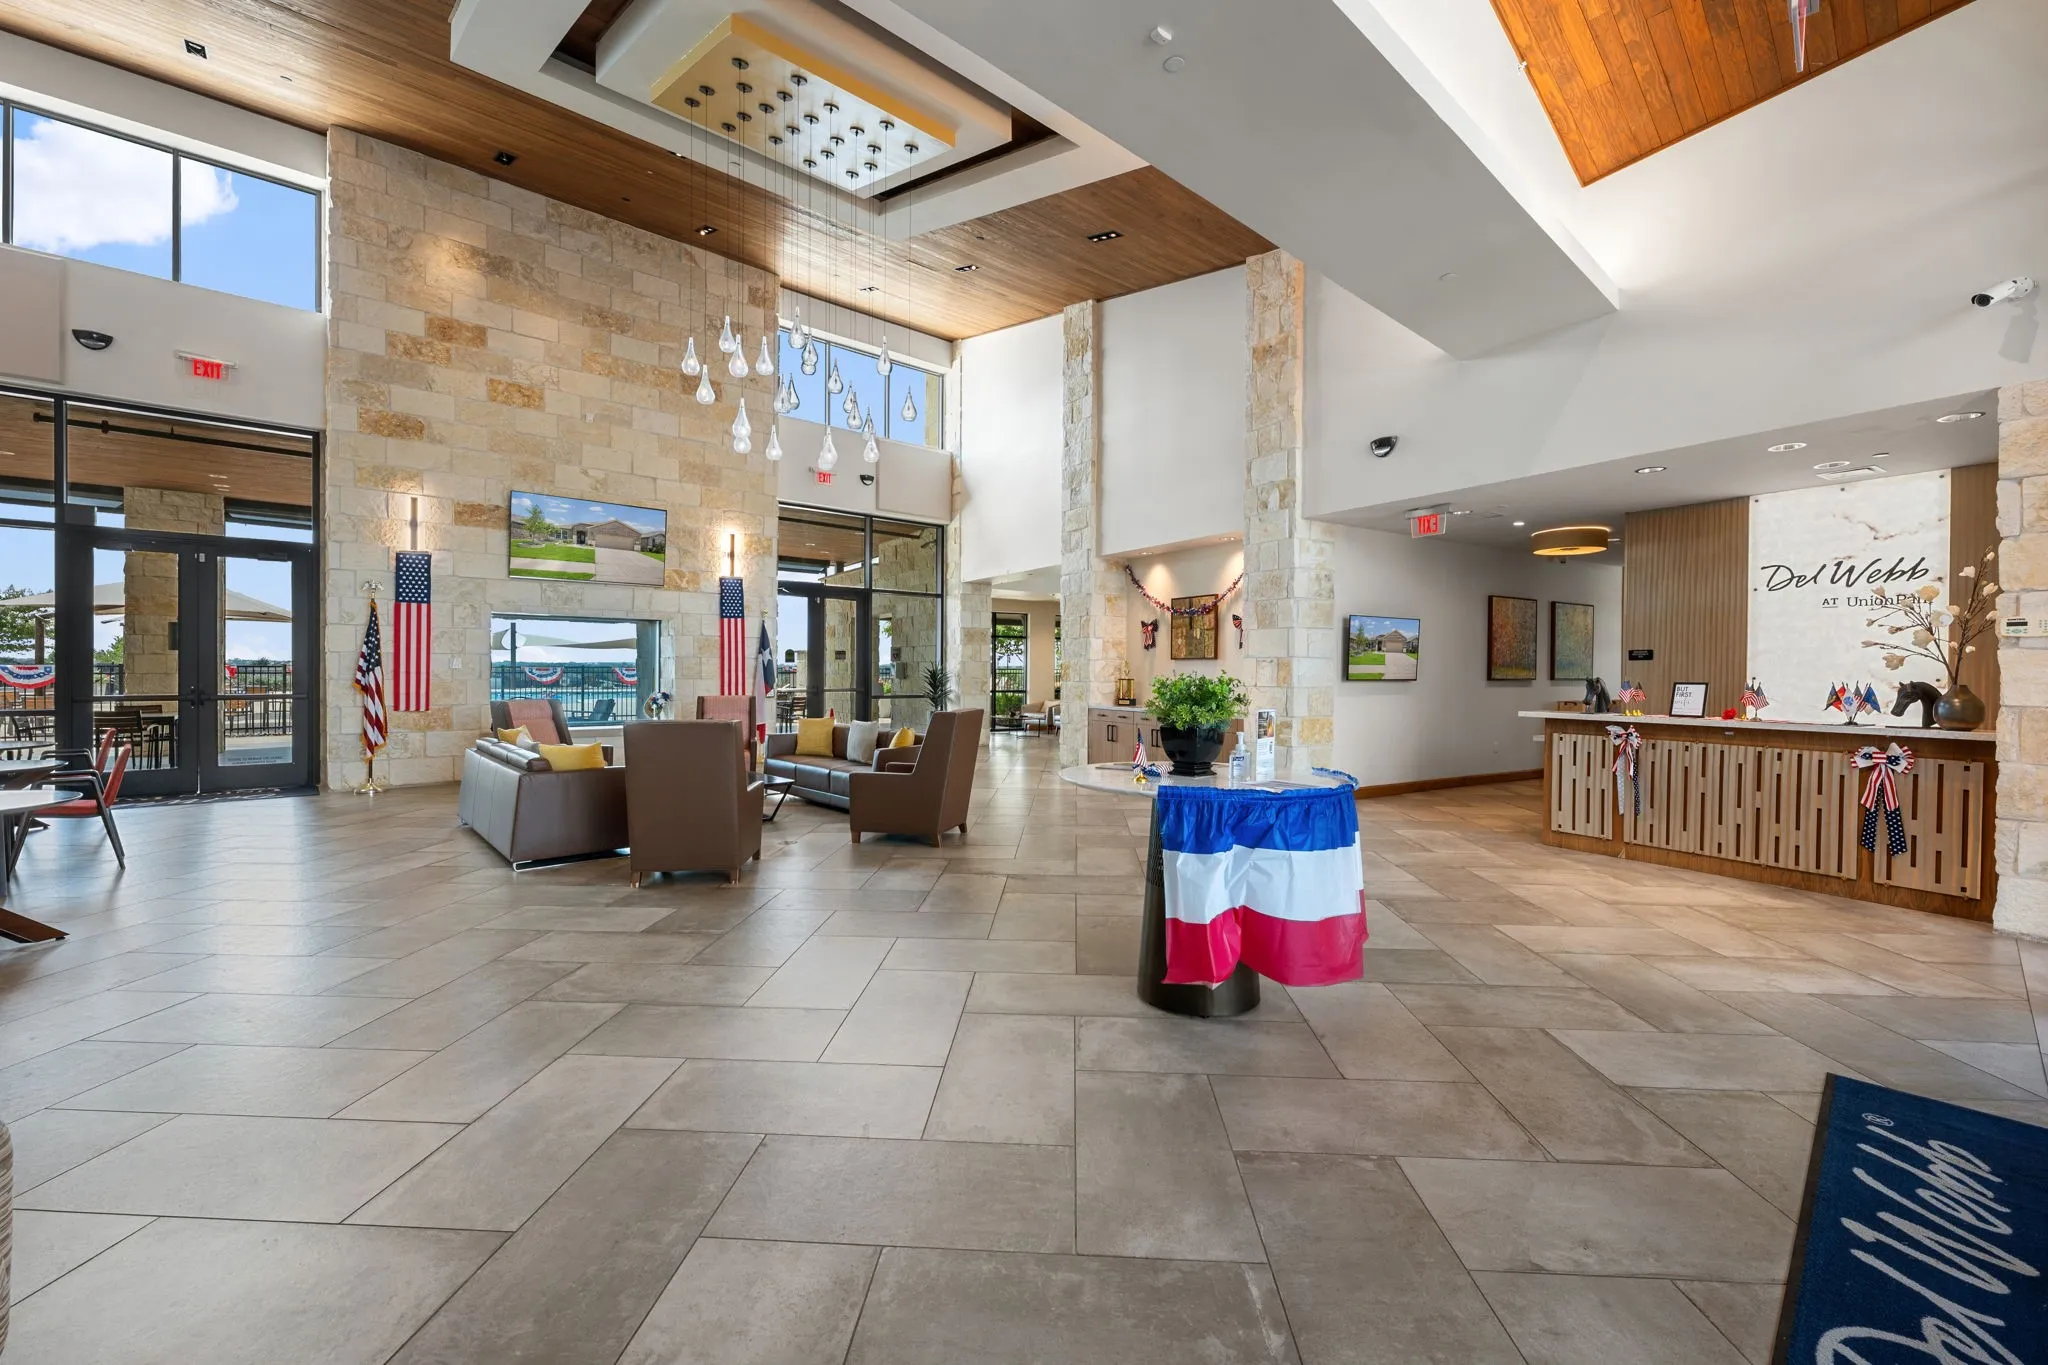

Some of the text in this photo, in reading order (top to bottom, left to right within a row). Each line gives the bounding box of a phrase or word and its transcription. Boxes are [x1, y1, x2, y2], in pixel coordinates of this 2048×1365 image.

[193, 359, 223, 380] EXIT
[818, 471, 832, 484] EXIT
[1760, 557, 1929, 592] Del Webb
[1822, 593, 1934, 608] AT UnionPar
